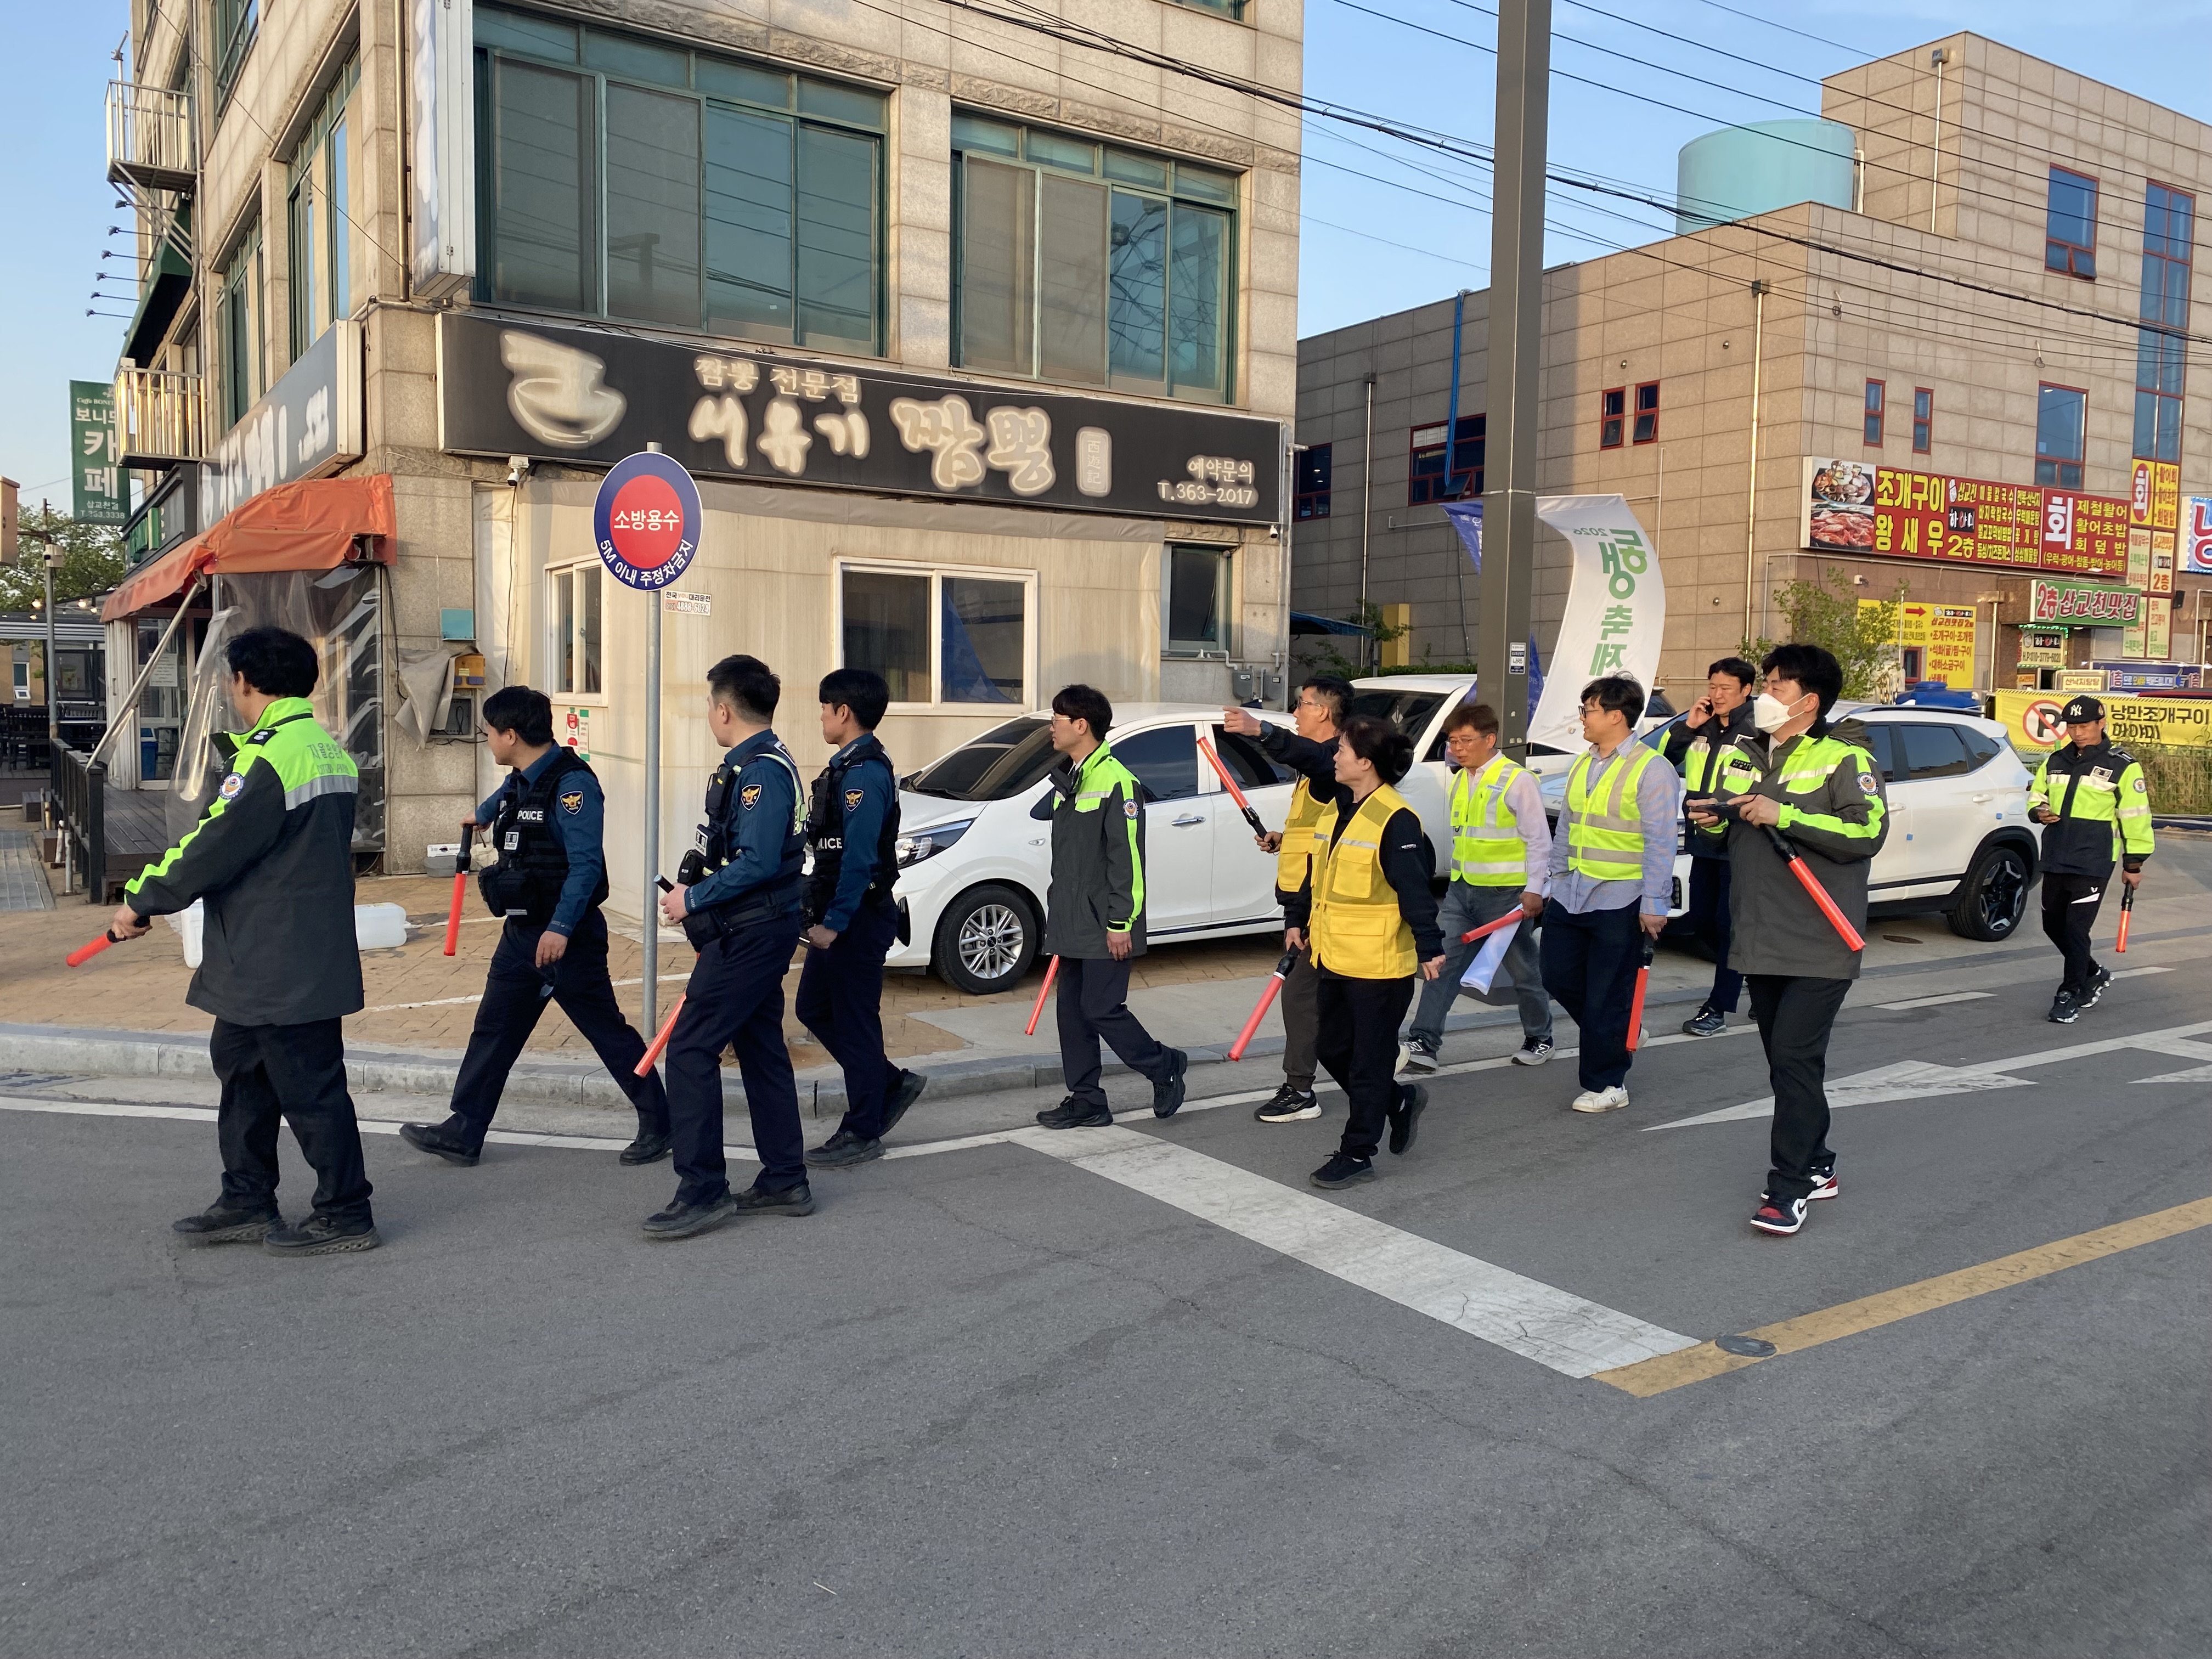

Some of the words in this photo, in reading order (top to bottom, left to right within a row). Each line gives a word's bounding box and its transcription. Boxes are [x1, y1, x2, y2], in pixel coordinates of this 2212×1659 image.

[695, 359, 759, 390] 짬뽕
[770, 368, 858, 403] 전문점
[1087, 439, 1102, 484] 西遊記
[1188, 457, 1252, 485] 예약문의
[1157, 482, 1252, 504] T.363-2017
[1877, 470, 1946, 514] 조개구이
[2134, 470, 2149, 516] 회
[613, 509, 680, 532] 소방용수
[2076, 500, 2128, 520] 제철활어
[2045, 495, 2074, 550] 회
[2075, 517, 2128, 538] 활어초밥
[1876, 514, 1944, 556] 왕새우
[1948, 534, 1974, 558] 2층
[2075, 537, 2127, 556] 회덮밥
[600, 539, 617, 563] 5M
[614, 562, 637, 585] 이내
[640, 538, 693, 587] 주정차금지
[2153, 573, 2169, 591] 2층
[676, 601, 709, 614] 4888-6024
[2037, 582, 2058, 621] 2층
[2059, 588, 2140, 621] 삽교천맛집
[1931, 659, 1965, 672] 대하소금구이
[2070, 704, 2083, 716] NY
[2111, 704, 2210, 725] 낭만조개구이
[517, 810, 544, 821] POLICE
